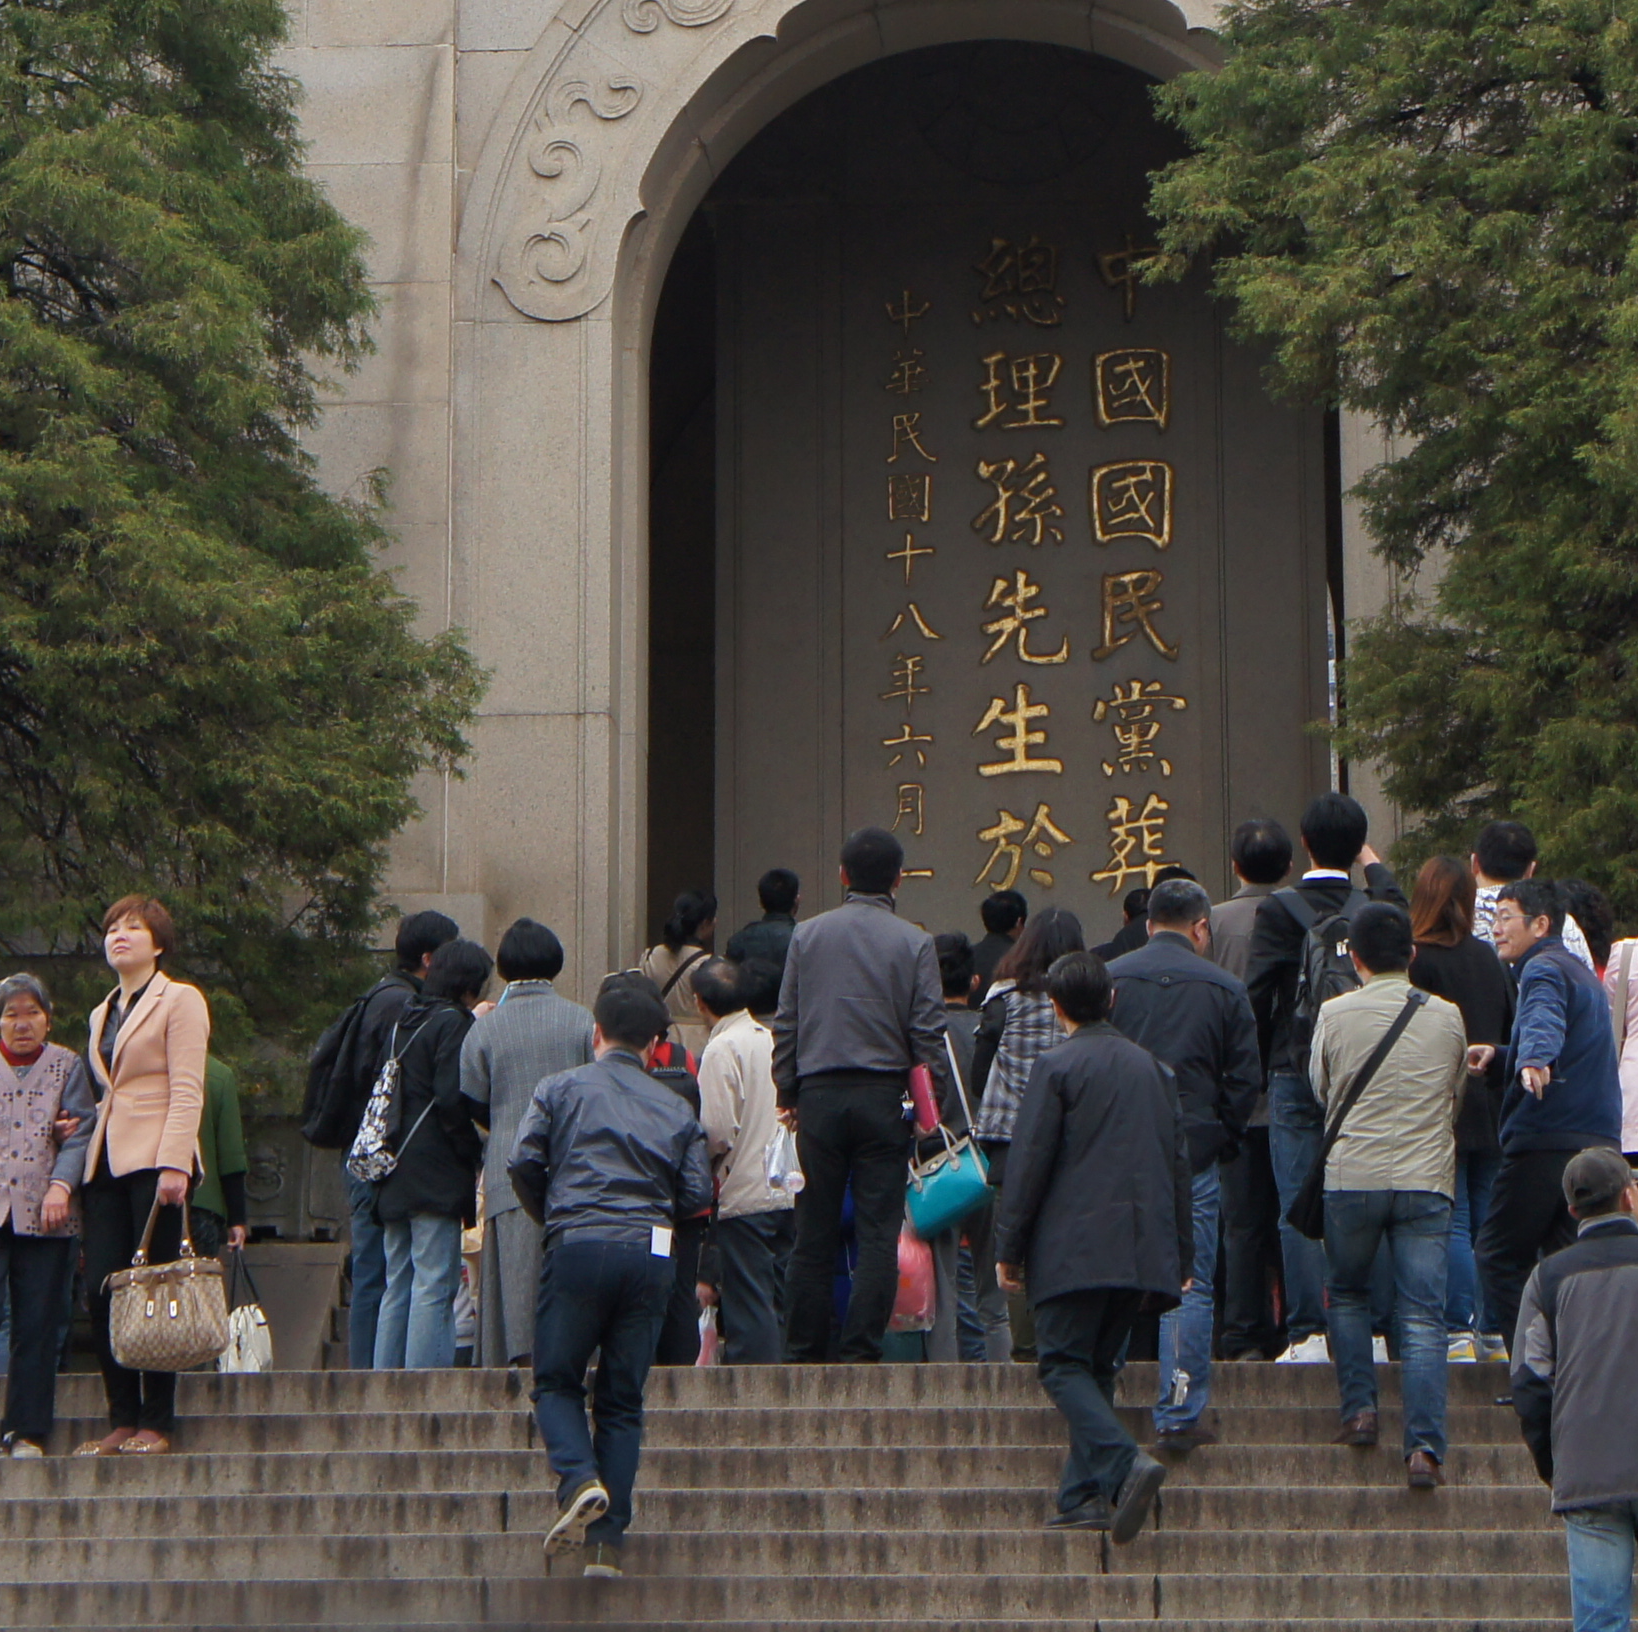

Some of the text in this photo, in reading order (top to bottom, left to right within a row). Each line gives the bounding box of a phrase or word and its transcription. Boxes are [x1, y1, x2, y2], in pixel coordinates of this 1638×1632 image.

[877, 288, 945, 929] 中華民國十八年六月一
[969, 234, 1076, 892] 總理孫先生於
[1090, 233, 1188, 896] 中國國民黨葬
